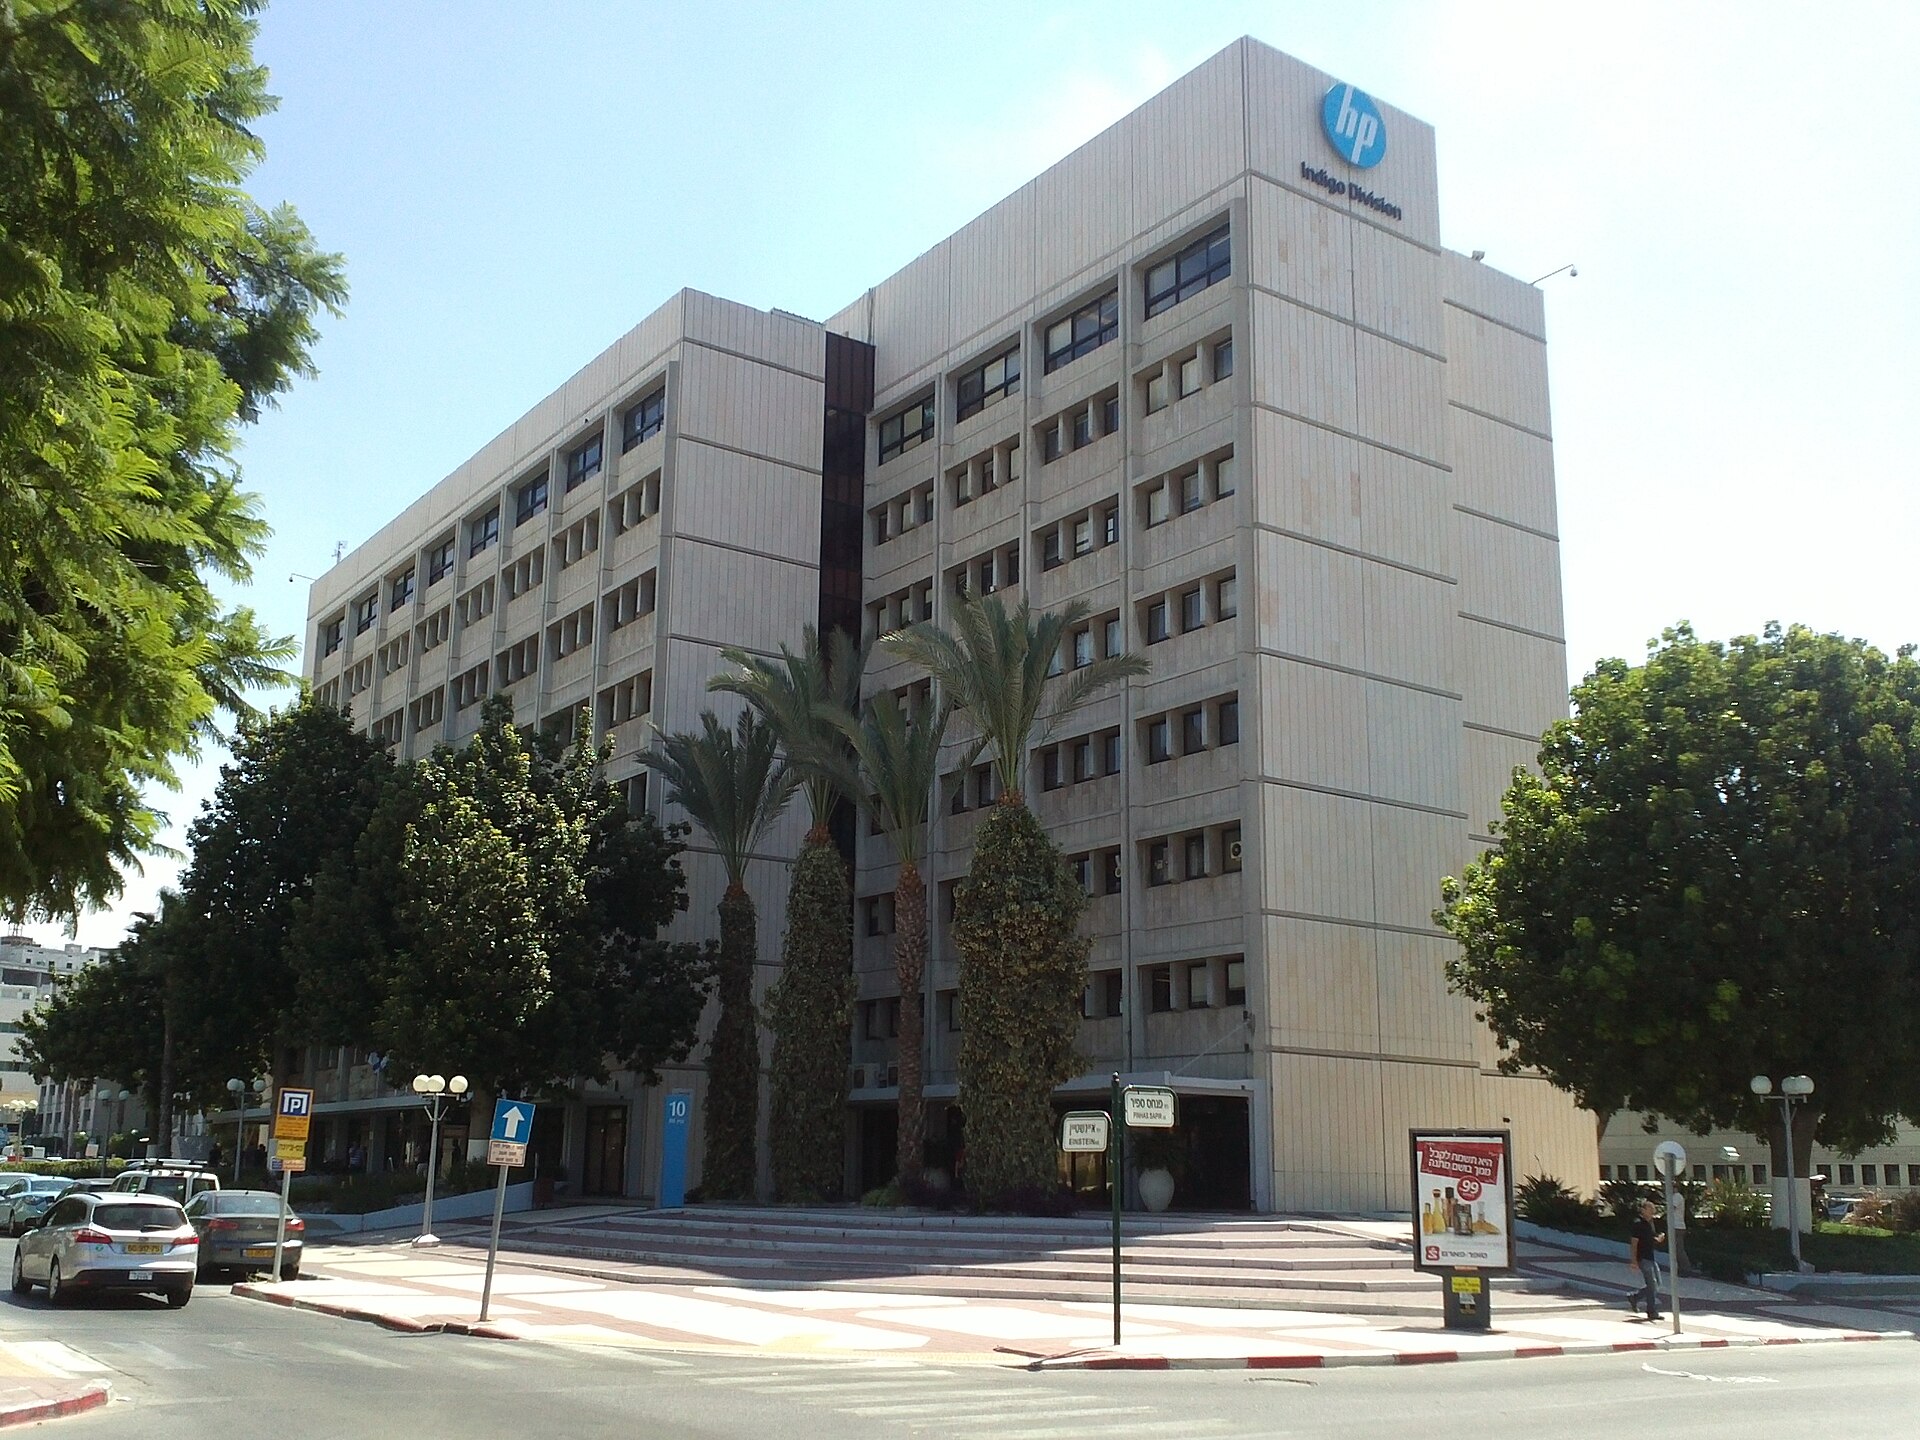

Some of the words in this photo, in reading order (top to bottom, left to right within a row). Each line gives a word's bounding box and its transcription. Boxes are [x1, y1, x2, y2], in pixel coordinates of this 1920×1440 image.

[1336, 85, 1378, 164] hp
[1301, 161, 1346, 195] Indigo
[1348, 182, 1402, 221] Division
[669, 1100, 686, 1117] 10
[1147, 1098, 1163, 1109] פנחס
[1069, 1138, 1096, 1146] EINSTEIN
[1429, 1147, 1451, 1160] לקבל
[1451, 1152, 1478, 1164] תשמח
[1428, 1158, 1451, 1170] מתנה
[1451, 1162, 1473, 1173] בושם
[1478, 1157, 1493, 1168] היא
[1474, 1166, 1492, 1176] ממך
[1462, 1180, 1479, 1194] 99
